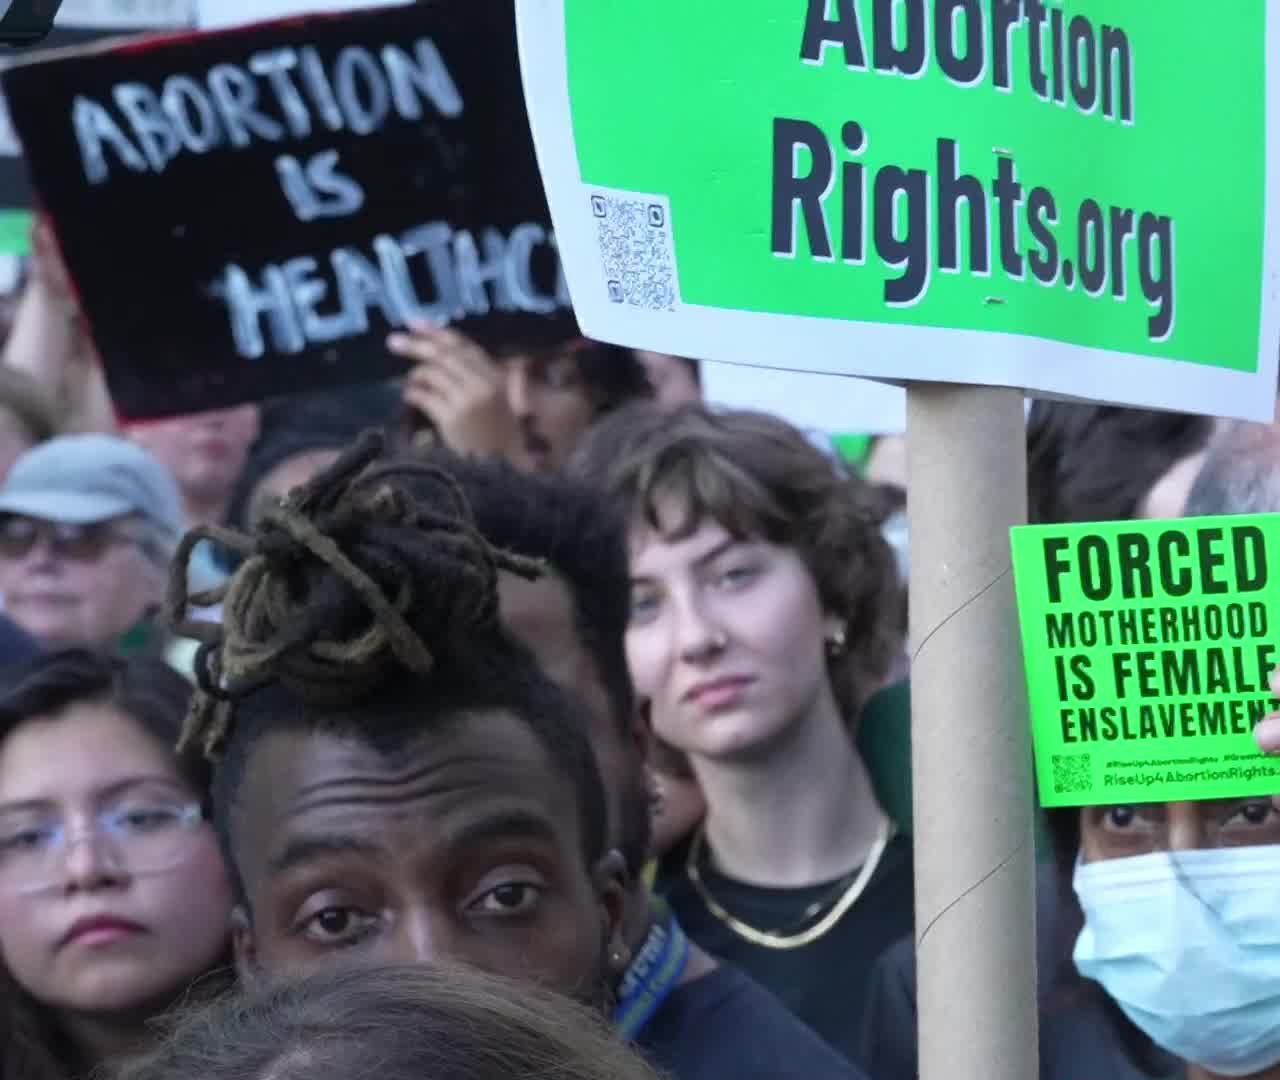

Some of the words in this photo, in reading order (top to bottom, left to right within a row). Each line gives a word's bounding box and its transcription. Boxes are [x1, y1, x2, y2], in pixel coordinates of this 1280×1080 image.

[72, 38, 464, 184] ABORTION
[800, 0, 1135, 125] Abortion
[274, 150, 365, 221] IS
[770, 117, 1177, 342] Rights.org
[212, 221, 573, 359] HEALTHC
[1043, 525, 1268, 603] FORCED
[1045, 601, 1268, 649] MOTHERHOOD
[1054, 654, 1096, 701] IS
[1112, 643, 1278, 699] FEMALE
